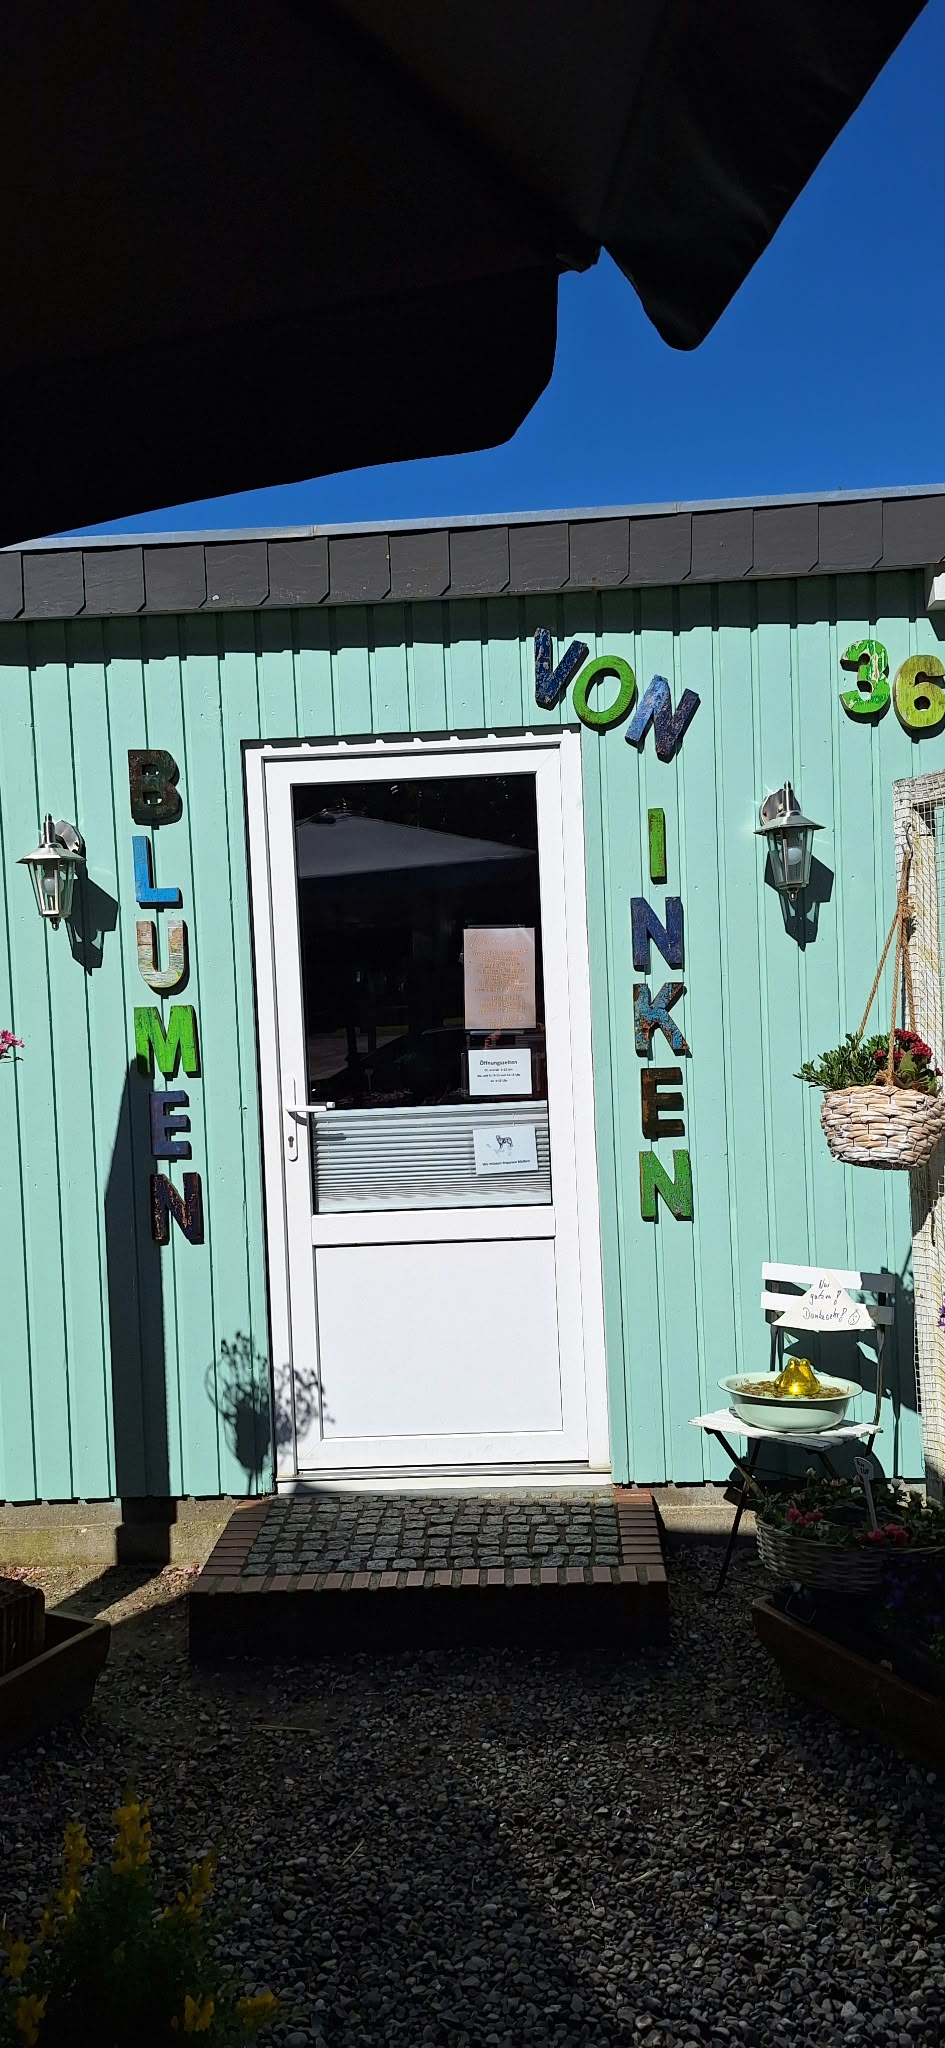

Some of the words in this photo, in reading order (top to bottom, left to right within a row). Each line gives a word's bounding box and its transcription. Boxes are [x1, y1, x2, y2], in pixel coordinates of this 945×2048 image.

[534, 627, 701, 763] VON
[840, 639, 945, 728] 36
[127, 749, 204, 1246] BLUMEN
[630, 807, 693, 1222] INKEN
